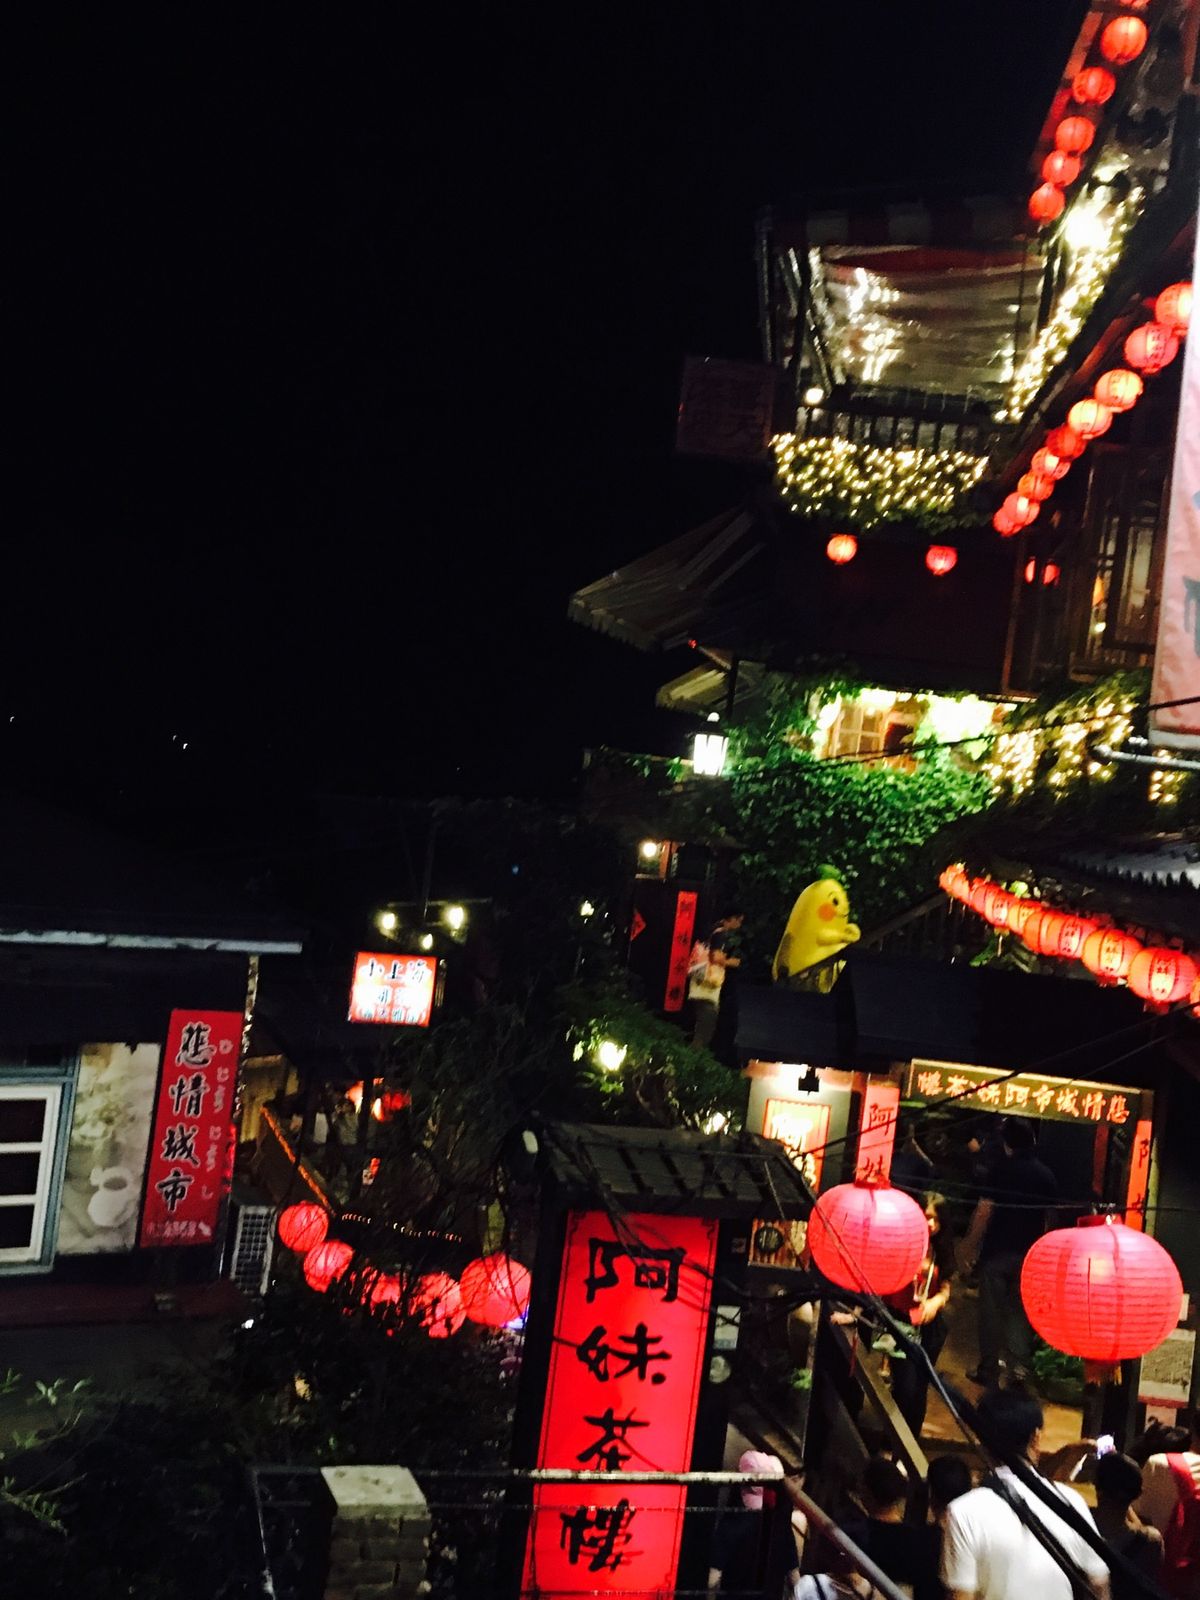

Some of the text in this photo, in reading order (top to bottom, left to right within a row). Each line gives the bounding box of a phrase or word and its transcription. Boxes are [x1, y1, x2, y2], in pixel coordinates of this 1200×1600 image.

[154, 1020, 217, 1213] 悲情城市
[559, 1235, 688, 1573] 阿妹茶樓
